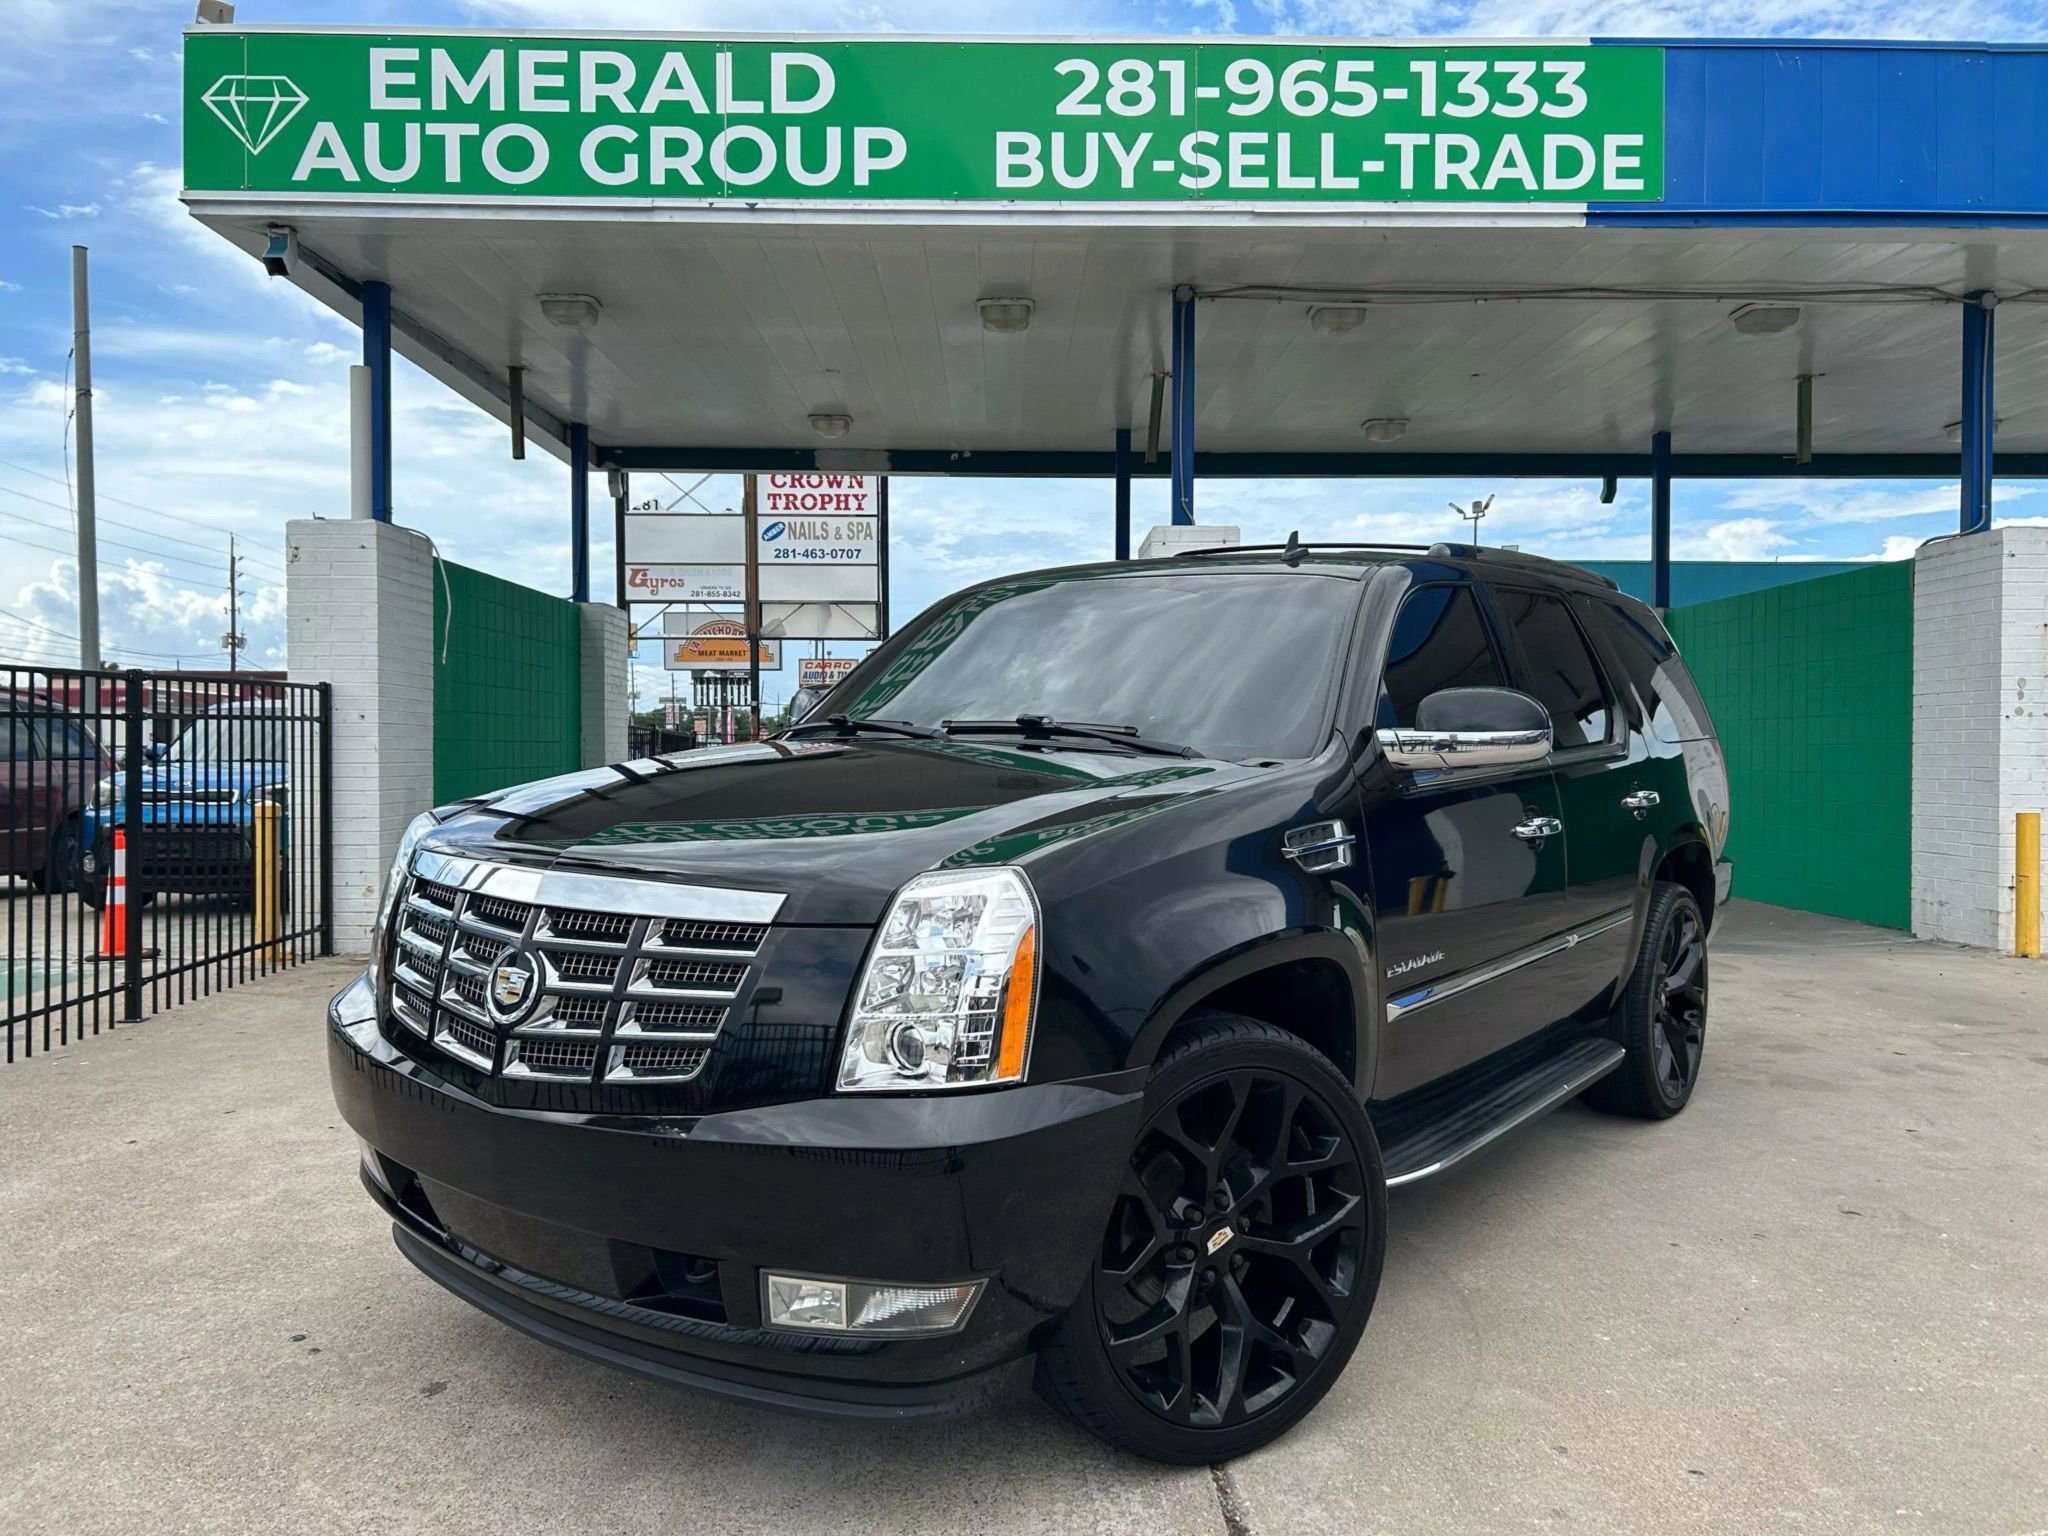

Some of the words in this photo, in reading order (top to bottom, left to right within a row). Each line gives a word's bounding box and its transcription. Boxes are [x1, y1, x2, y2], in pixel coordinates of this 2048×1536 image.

[371, 47, 836, 115] EMERALD
[1055, 58, 1588, 118] 281-965-1333
[292, 122, 550, 184] AUTO
[580, 124, 907, 188] GROUP
[996, 131, 1645, 191] BUY-SELL-TRADE
[770, 473, 864, 489] CROWN
[767, 493, 868, 511] TROPHY
[762, 522, 785, 541] AMBER
[787, 521, 829, 541] NAILS
[834, 526, 843, 541] &
[847, 521, 874, 541] SPA
[774, 548, 862, 560] 281-463-0707
[628, 568, 685, 596] Gyros
[690, 590, 742, 598] 281-855-8342
[698, 649, 717, 657] MEAT
[718, 649, 747, 657] MARKET
[802, 670, 828, 680] AUDIO
[828, 670, 835, 680] &
